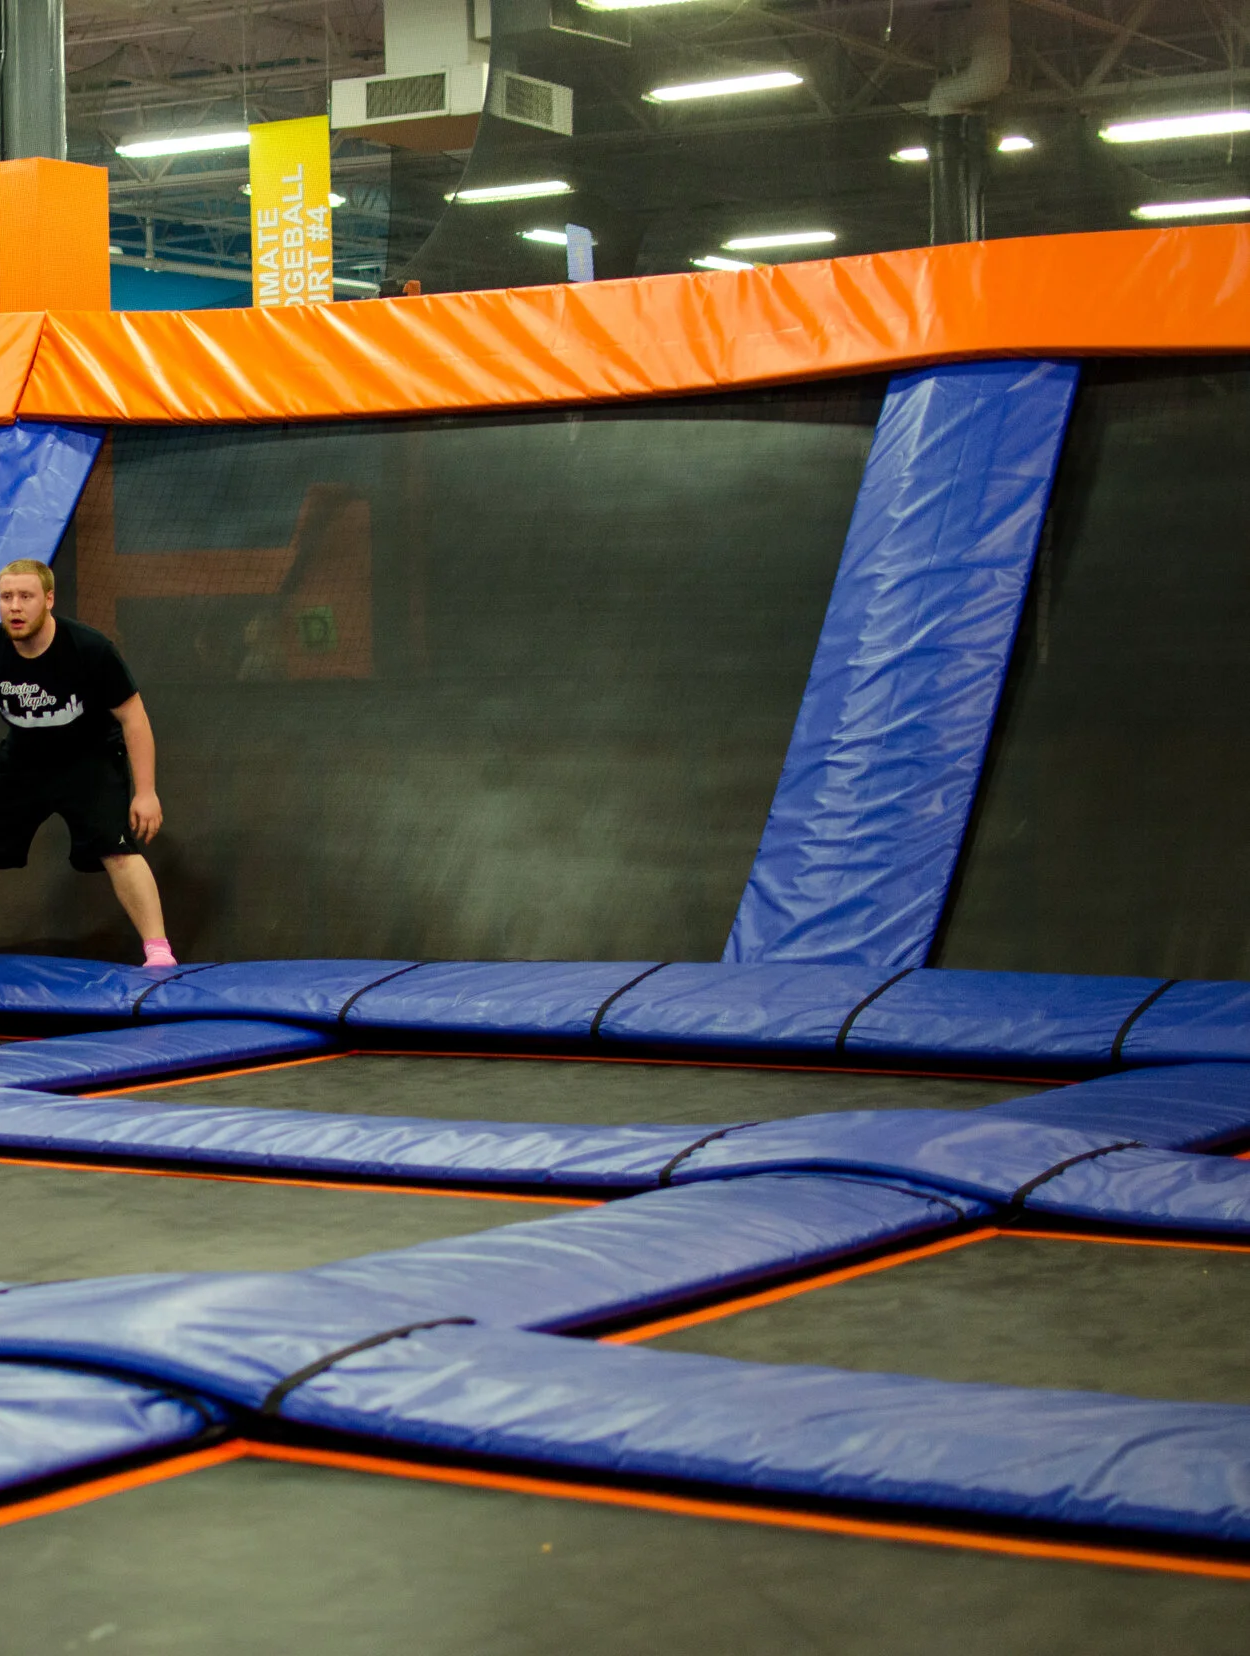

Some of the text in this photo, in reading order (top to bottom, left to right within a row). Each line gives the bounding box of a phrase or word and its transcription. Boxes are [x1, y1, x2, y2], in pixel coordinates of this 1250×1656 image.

[305, 204, 330, 243] #4
[0, 681, 41, 696] Boston
[17, 689, 58, 711] Vapor
